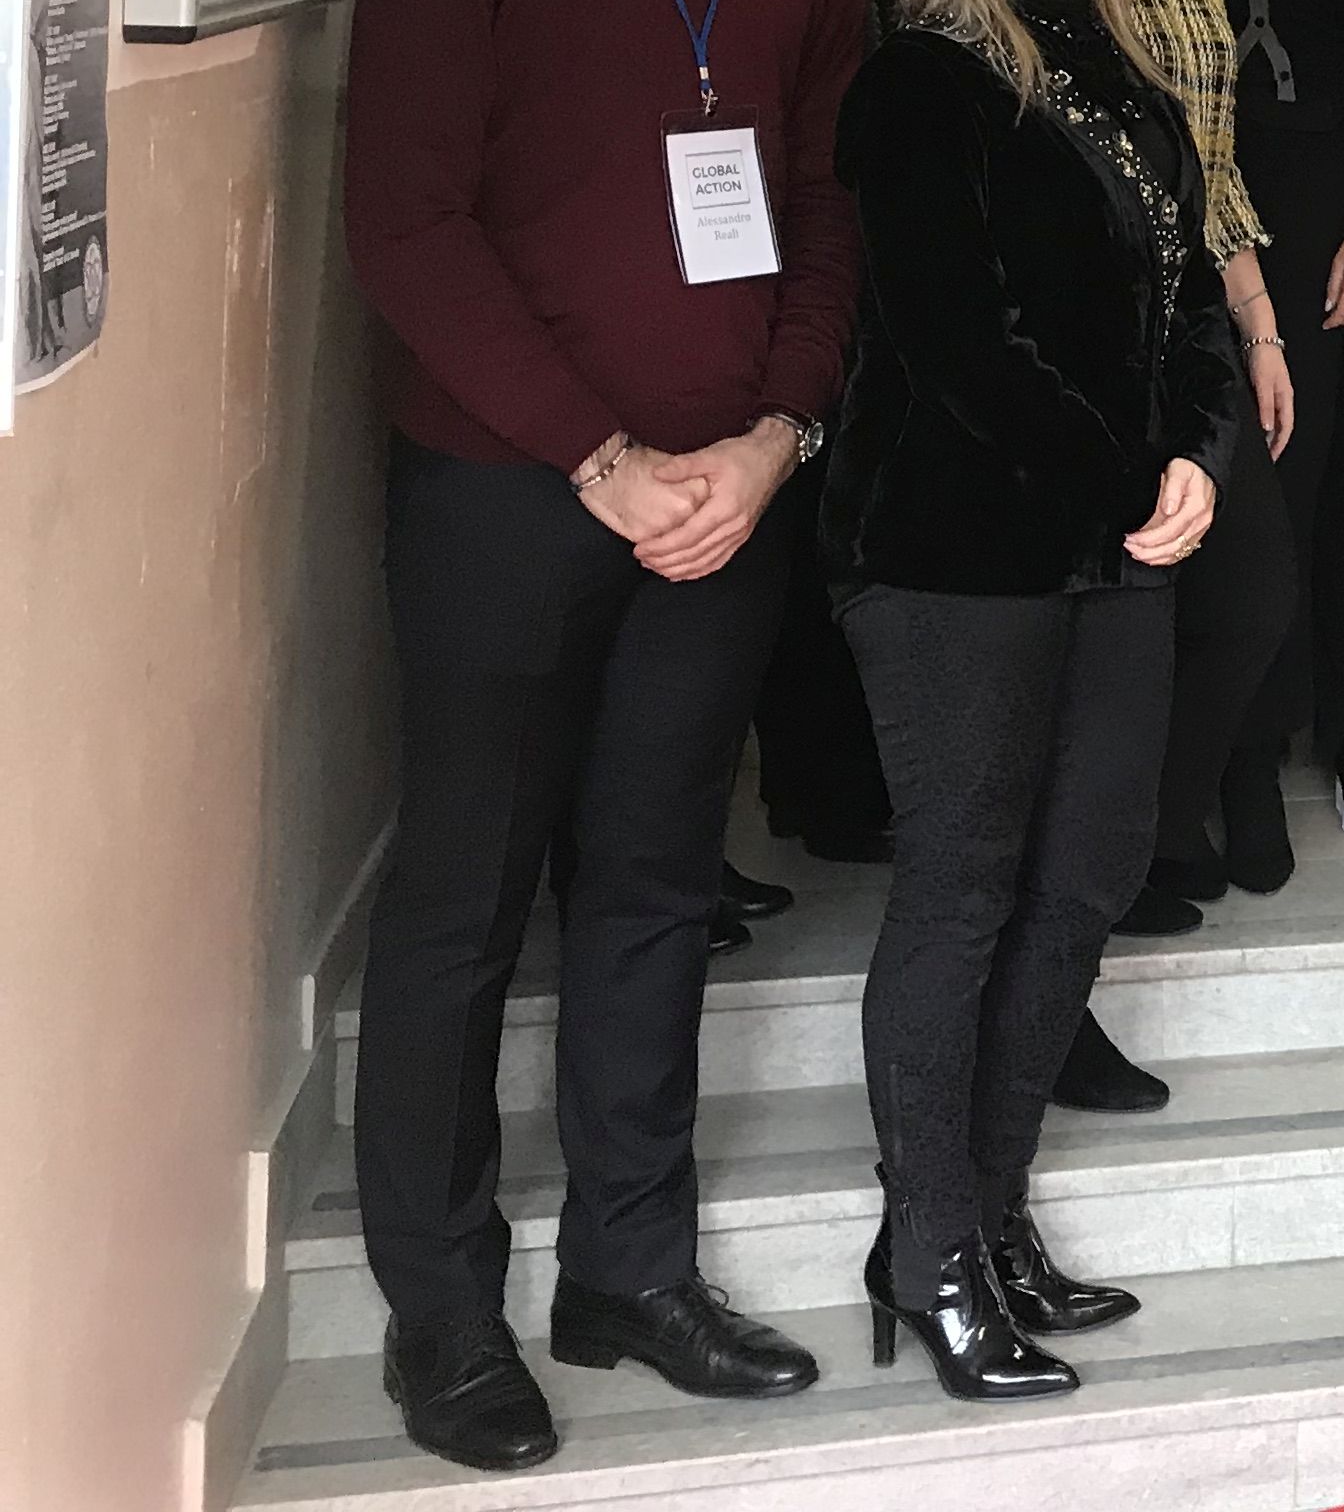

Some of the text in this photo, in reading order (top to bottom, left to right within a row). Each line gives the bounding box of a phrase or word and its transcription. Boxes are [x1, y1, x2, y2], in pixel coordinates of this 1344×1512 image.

[692, 164, 740, 178] GLOBAL
[695, 180, 742, 196] ACTION
[697, 211, 752, 228] Alessandro
